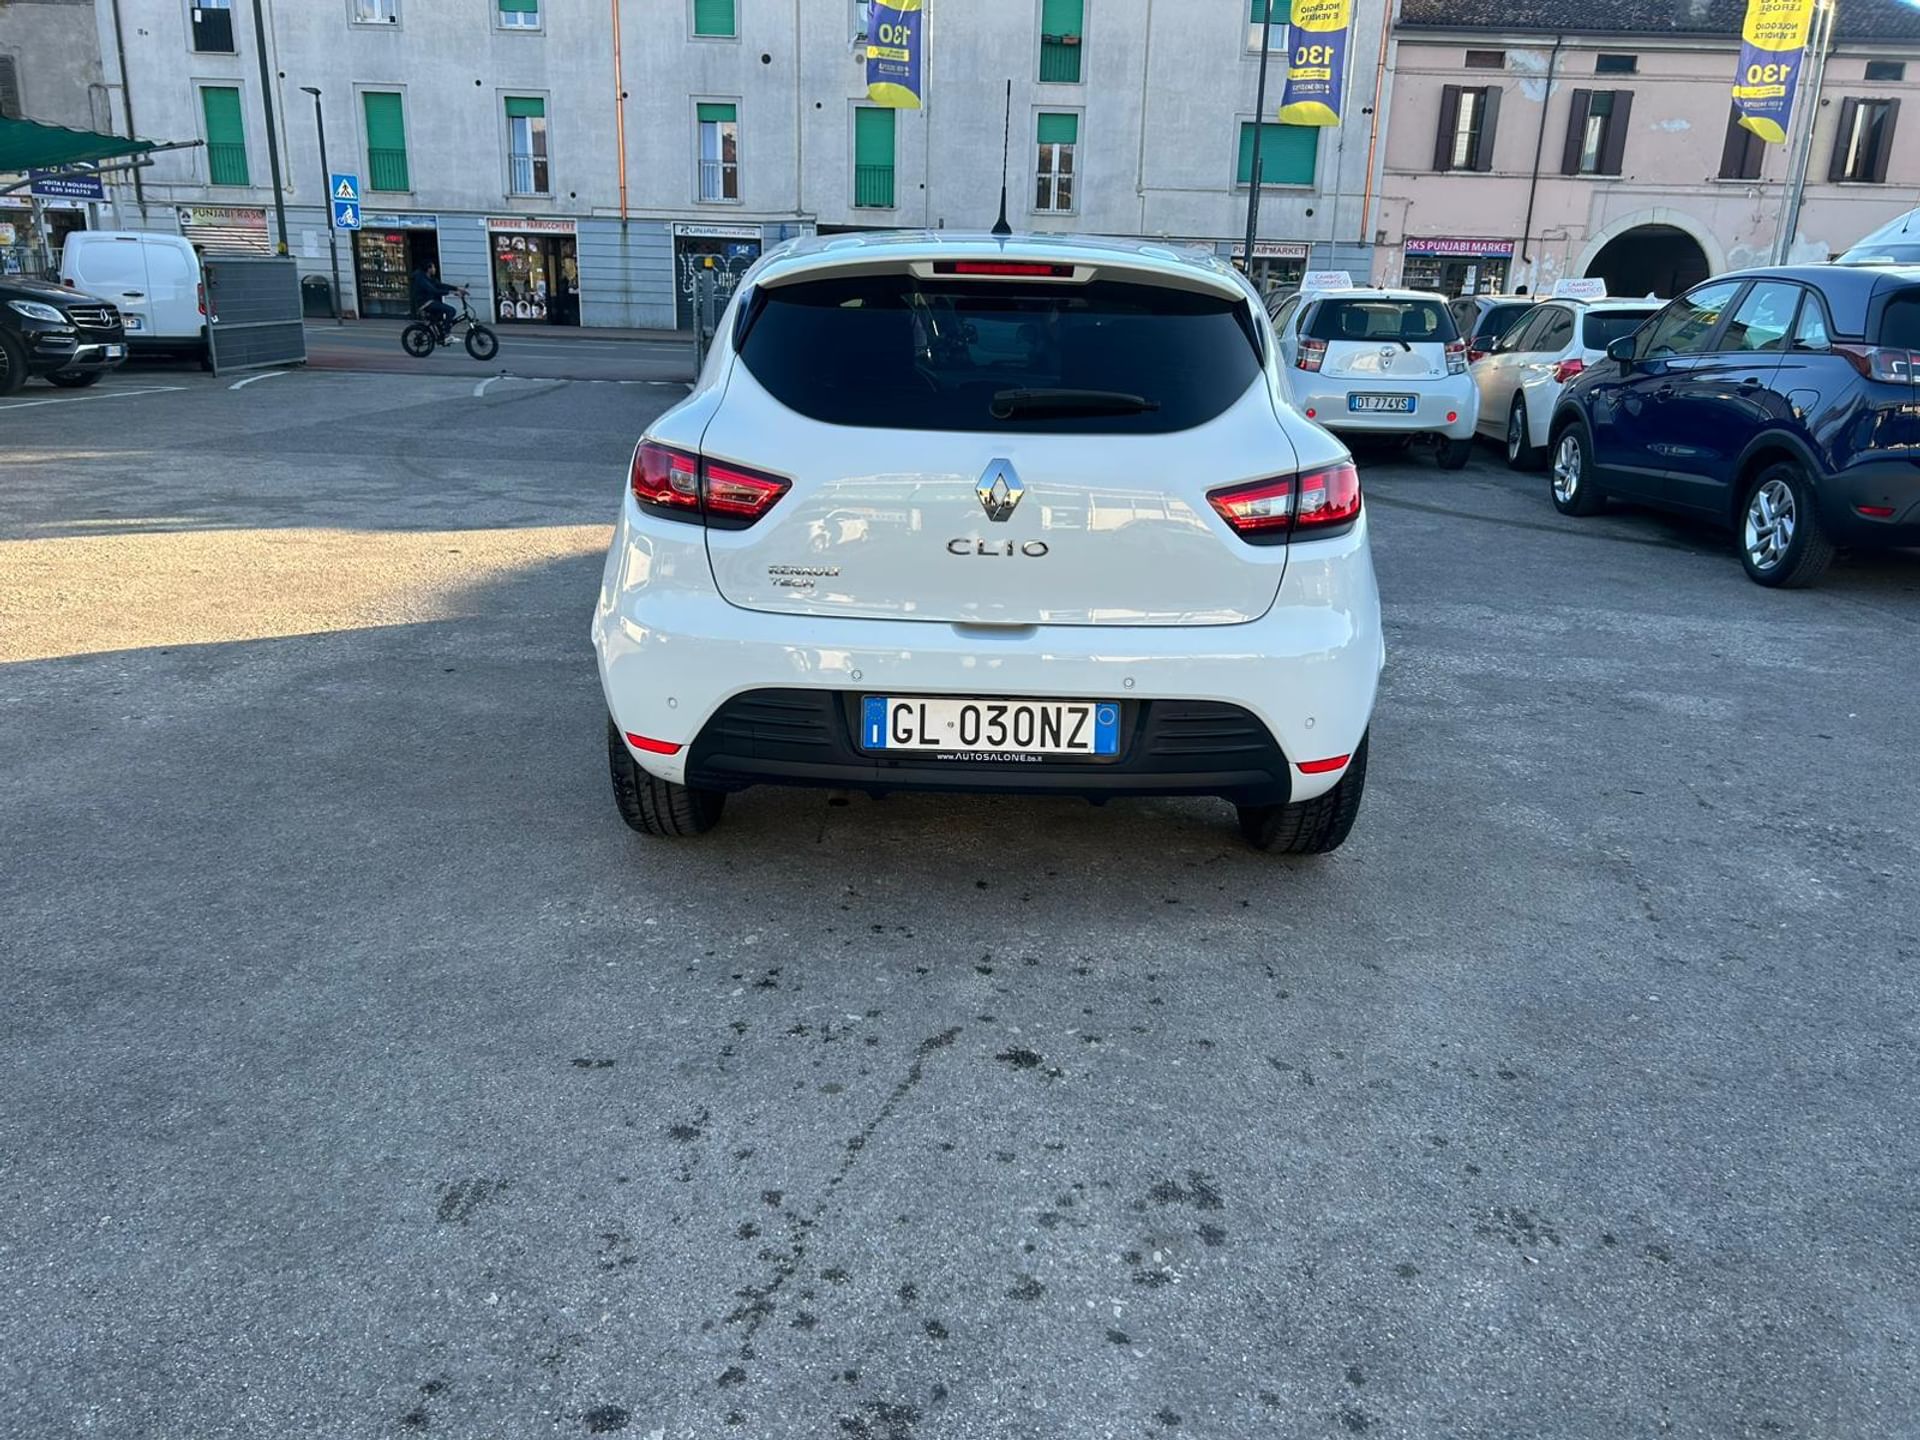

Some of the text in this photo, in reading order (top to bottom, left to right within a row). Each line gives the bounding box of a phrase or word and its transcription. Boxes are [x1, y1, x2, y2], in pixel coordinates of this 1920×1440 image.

[1269, 247, 1306, 256] MARKET
[1407, 240, 1513, 253] SKS PUNJABI MARKET
[1358, 397, 1370, 407] DT
[946, 538, 1049, 557] CLIO
[768, 565, 840, 577] RENAULT
[769, 578, 815, 588] TECH
[892, 703, 940, 745] GL
[959, 704, 1089, 749] 030NZ
